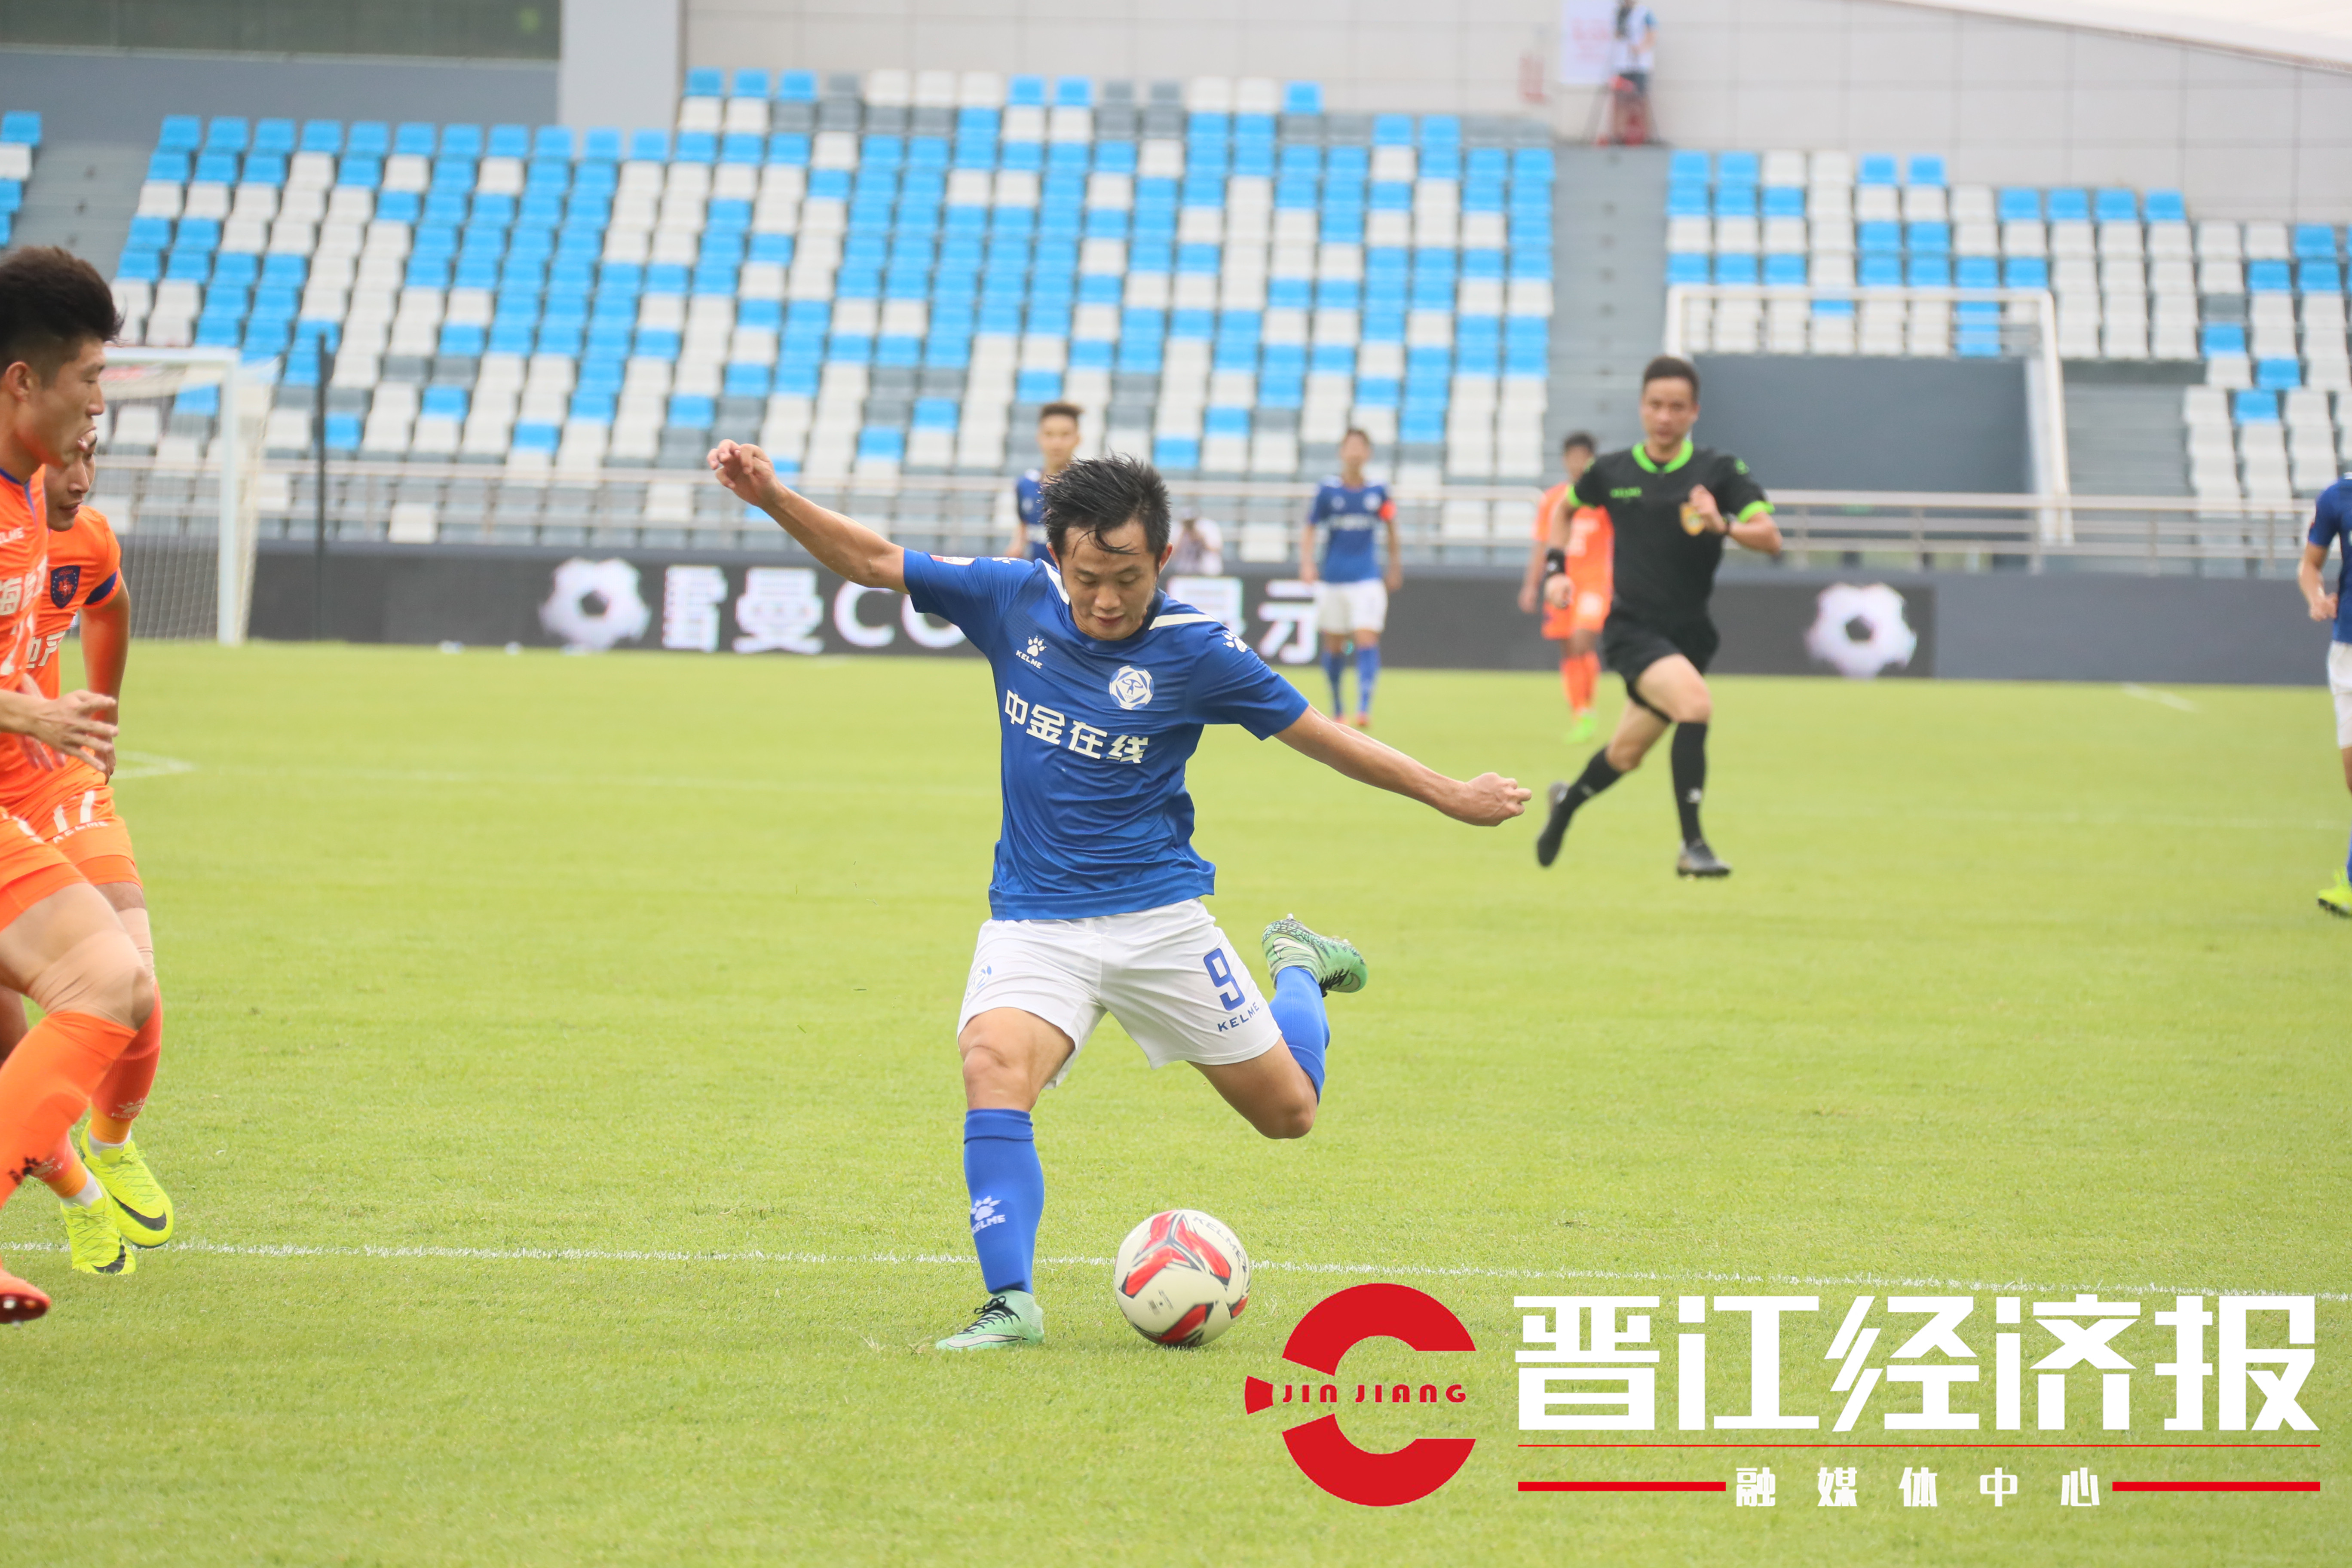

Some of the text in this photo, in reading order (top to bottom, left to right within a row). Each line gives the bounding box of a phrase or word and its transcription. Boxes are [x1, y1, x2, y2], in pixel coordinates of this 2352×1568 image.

[1016, 650, 1043, 669] KELME
[1004, 689, 1149, 764] 中金在线
[1203, 948, 1246, 1011] 9
[1217, 1001, 1260, 1032] KELME
[1193, 1216, 1243, 1262] KELME
